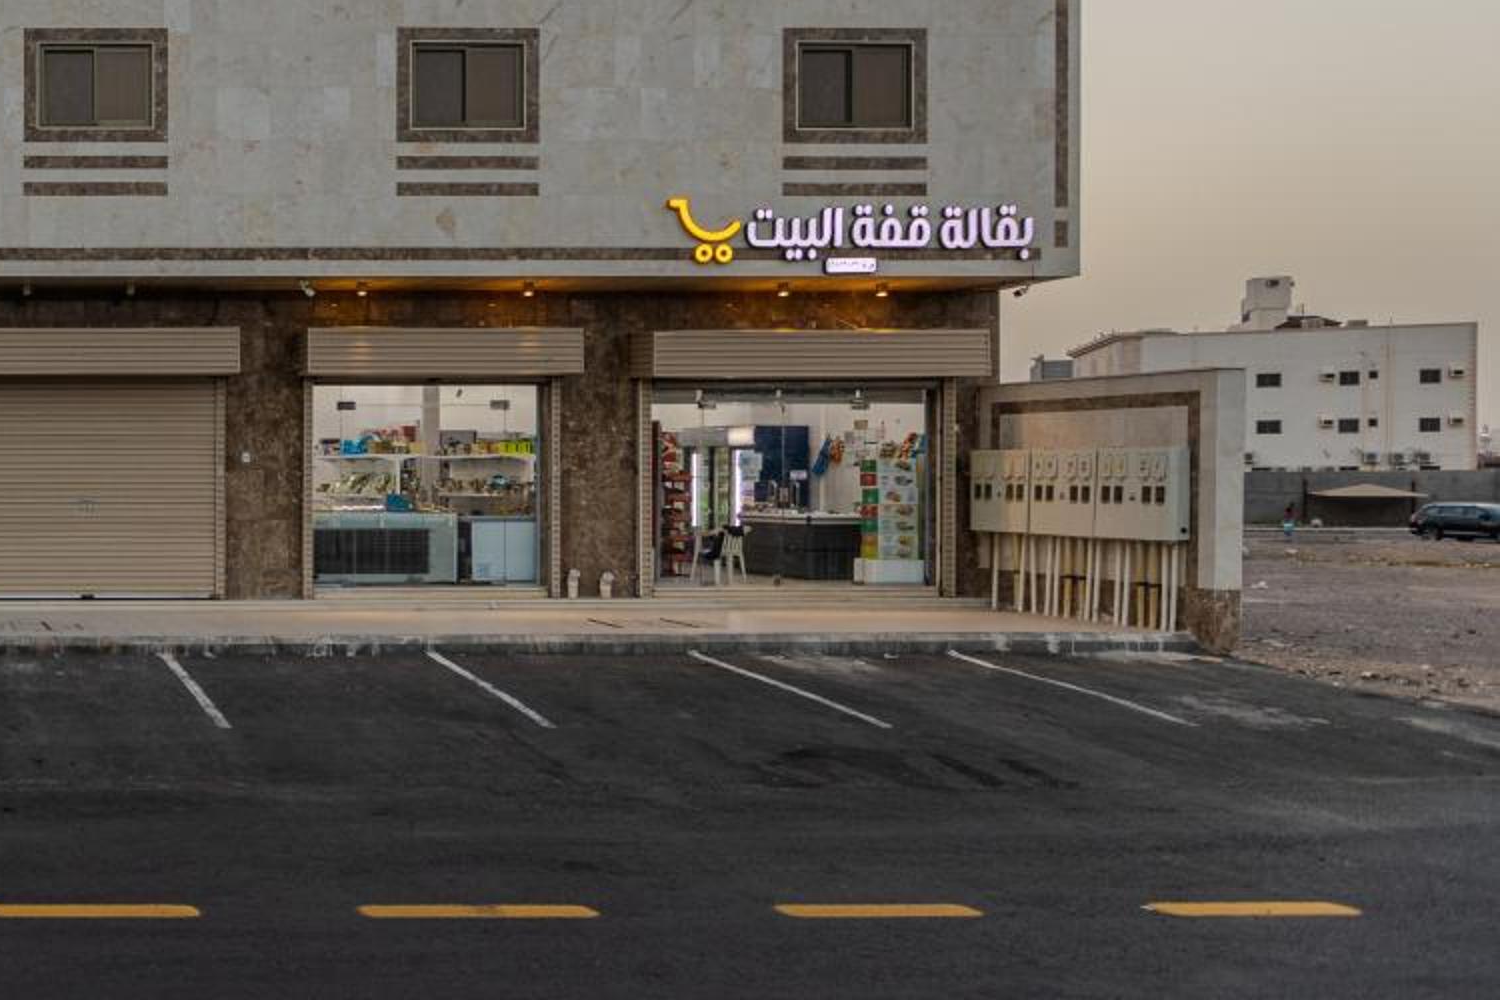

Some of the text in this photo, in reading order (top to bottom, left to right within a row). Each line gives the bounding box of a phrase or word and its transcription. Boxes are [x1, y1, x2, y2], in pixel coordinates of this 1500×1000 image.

[747, 204, 1034, 260] بقالة قفة البيت
